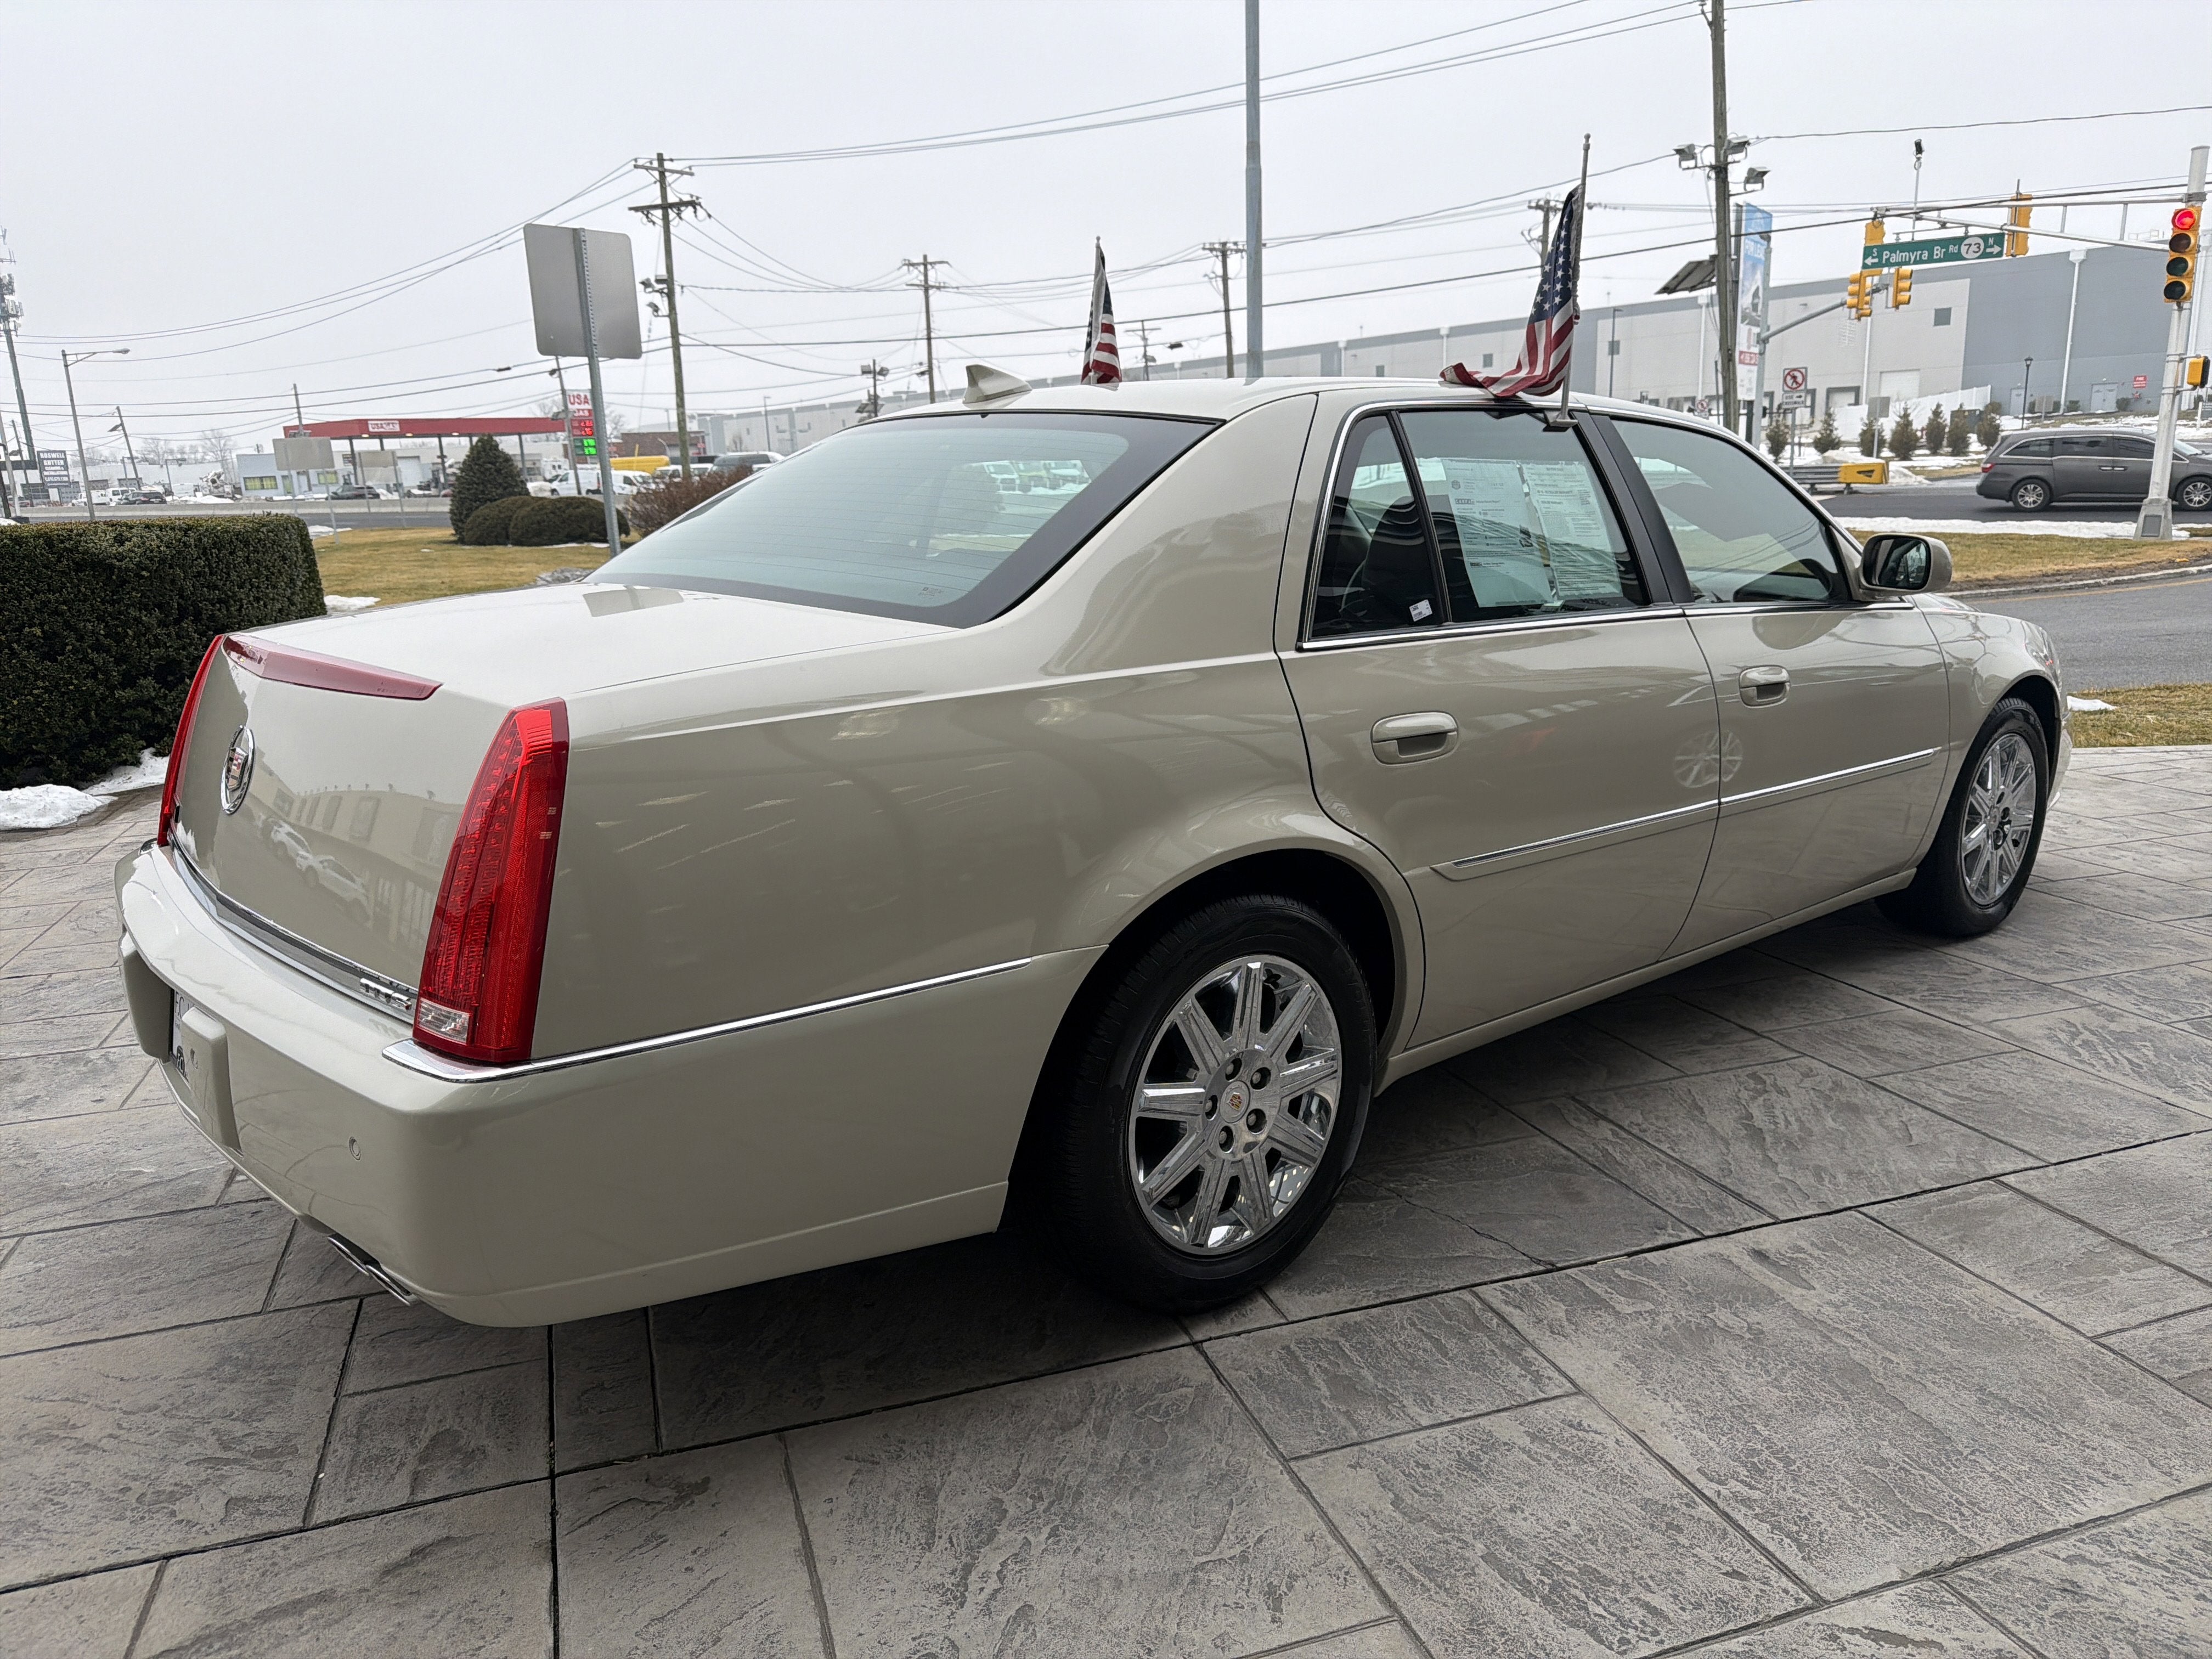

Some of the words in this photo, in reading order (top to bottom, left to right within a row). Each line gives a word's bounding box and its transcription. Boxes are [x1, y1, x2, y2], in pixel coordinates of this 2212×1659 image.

[1988, 237, 1994, 245] N
[1872, 248, 1877, 257] S
[1963, 242, 1981, 255] 73
[1882, 250, 1928, 264] Palmyra
[1933, 246, 1946, 259] Br
[1949, 245, 1958, 253] Rd
[568, 394, 590, 405] USA
